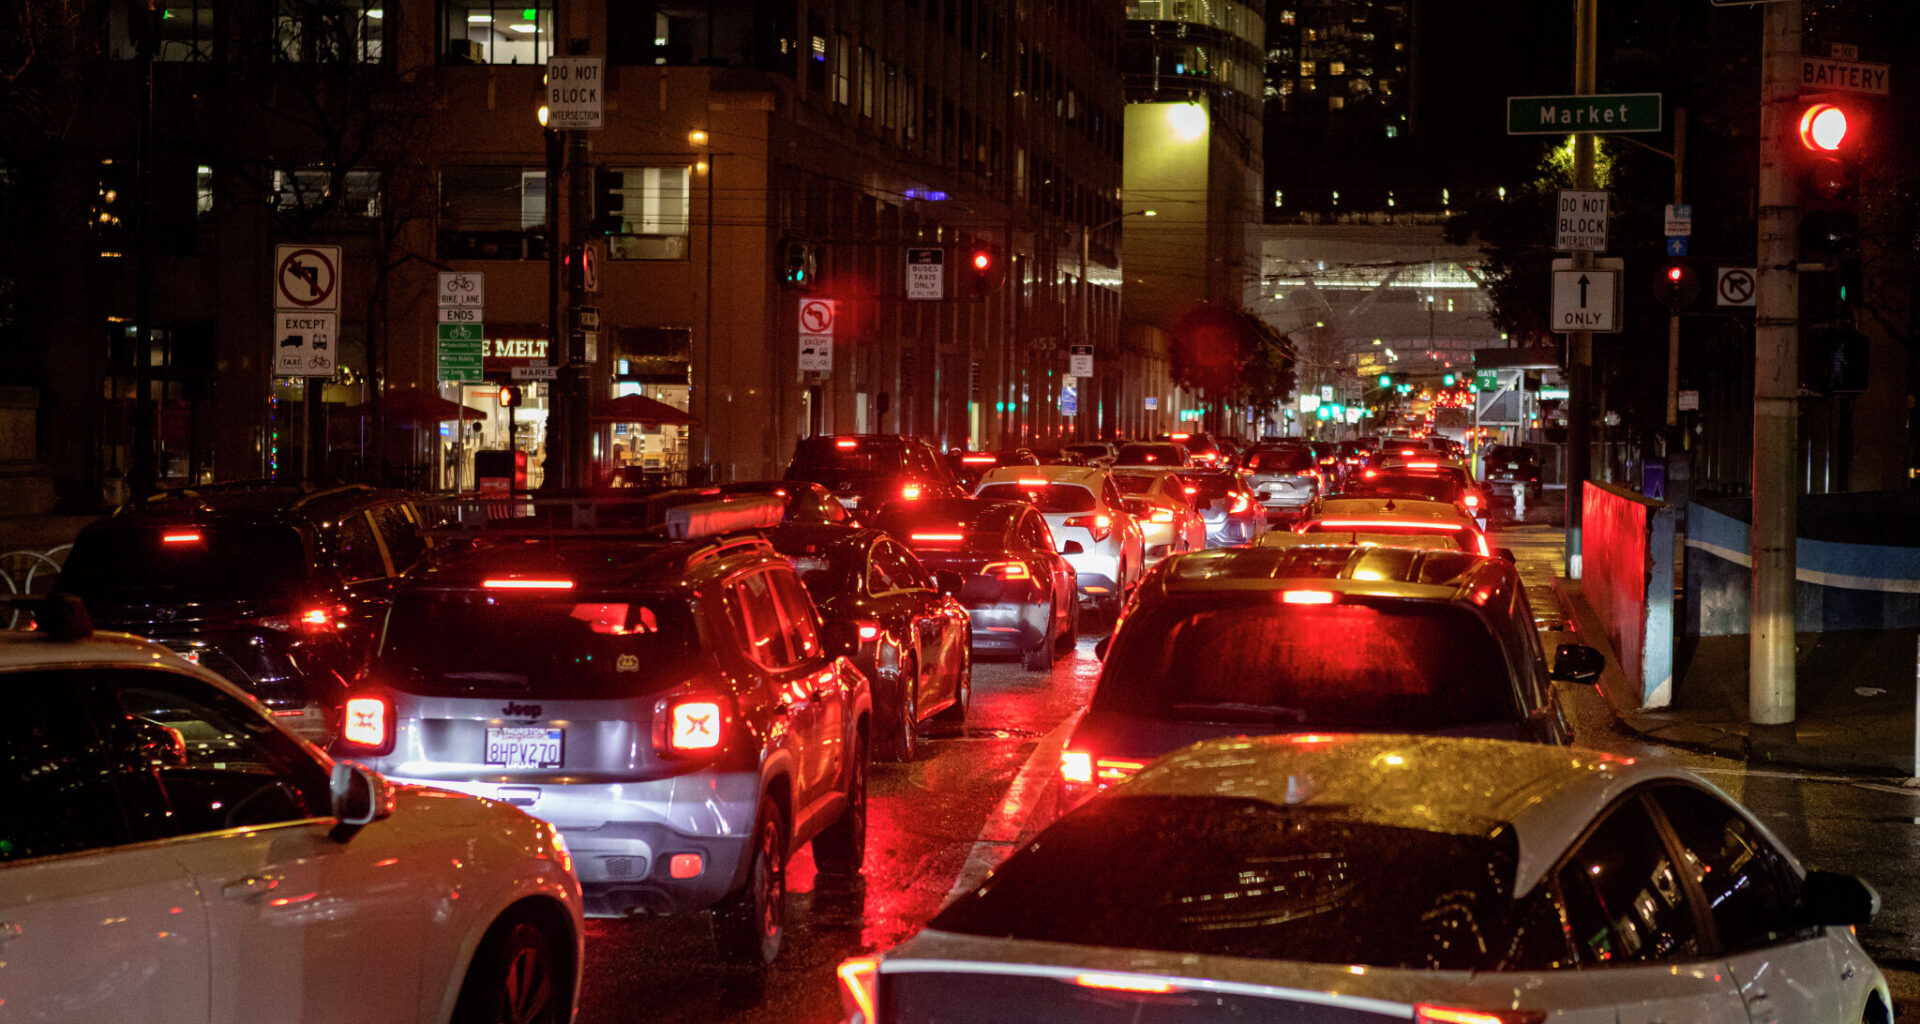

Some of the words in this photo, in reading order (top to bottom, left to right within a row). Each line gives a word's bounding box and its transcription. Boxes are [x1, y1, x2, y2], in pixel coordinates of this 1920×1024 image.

[552, 65, 568, 80] DO
[575, 66, 597, 80] NOT
[1803, 62, 1885, 90] BATTERY
[552, 88, 596, 103] BLOCK
[552, 111, 599, 121] INTERSECTION
[1540, 104, 1628, 124] Market
[1562, 198, 1577, 212] DO
[1583, 199, 1605, 213] NOT
[1561, 219, 1604, 233] BLOCK
[1560, 236, 1604, 247] INTERSECTION
[441, 295, 458, 303] BIKE
[461, 295, 481, 303] LANE
[447, 310, 474, 321] ENDS
[1564, 312, 1602, 325] ONLY
[285, 319, 326, 329] EXCEPT
[495, 340, 549, 357] MELT
[283, 358, 301, 366] TAXI
[520, 369, 554, 377] MARKE
[1477, 370, 1498, 378] GATE
[1483, 379, 1491, 388] 2
[502, 701, 542, 719] Jeep
[489, 743, 558, 764] 8HPV270
